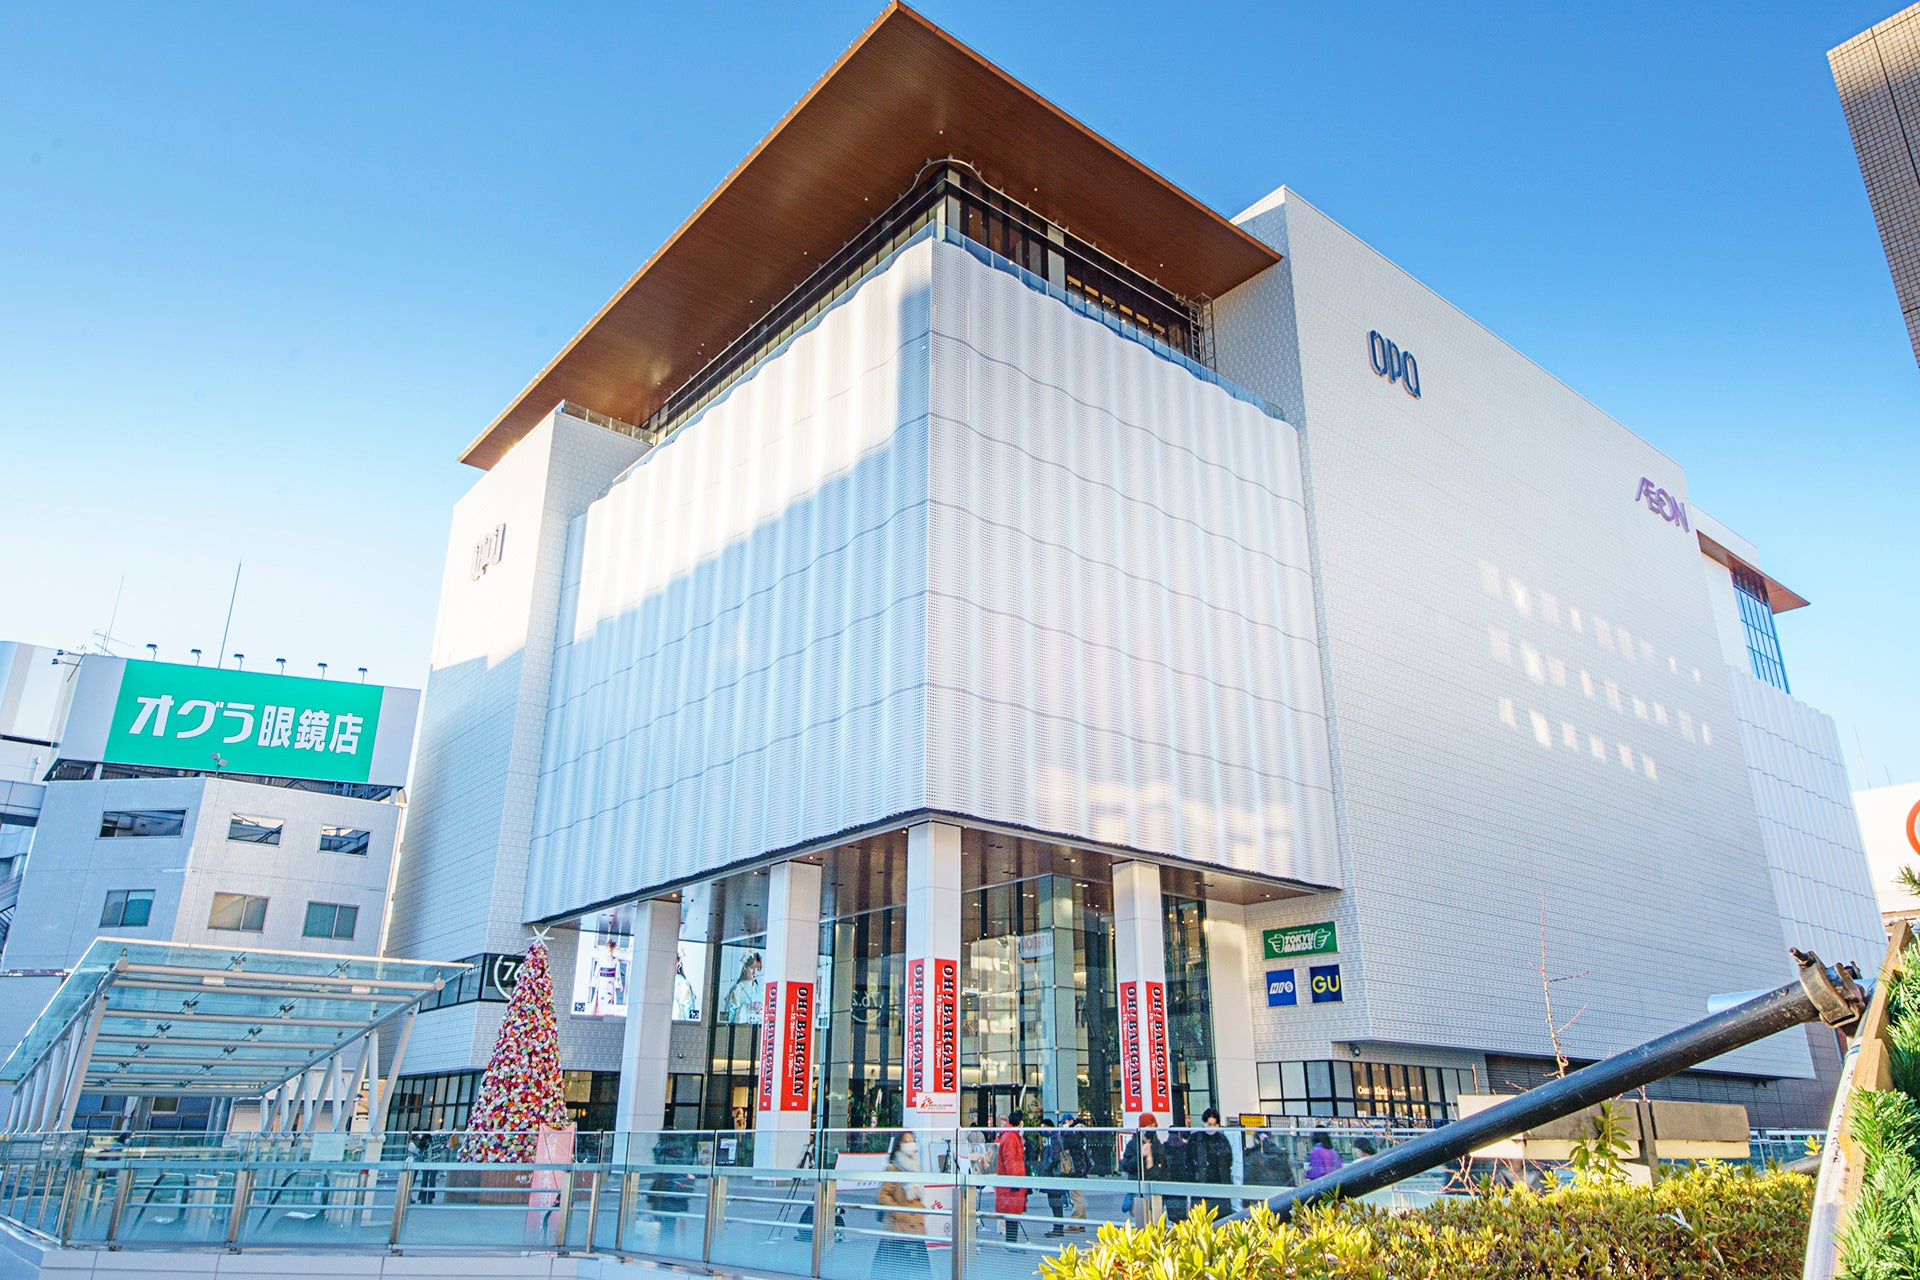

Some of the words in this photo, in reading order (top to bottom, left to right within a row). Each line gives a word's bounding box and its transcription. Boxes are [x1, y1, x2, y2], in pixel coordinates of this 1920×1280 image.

[128, 694, 364, 755] オグラ眼鏡店
[1284, 933, 1314, 945] TOKYU
[1284, 941, 1313, 953] HANDS
[913, 964, 924, 1000] OH!
[941, 964, 954, 1000] OH!
[1269, 981, 1294, 995] HIS
[1312, 975, 1340, 993] GU
[767, 986, 778, 1018] OH!
[796, 986, 809, 1018] OH!
[1126, 986, 1137, 1018] OH!
[1151, 986, 1162, 1018] OH!
[764, 1020, 776, 1097] BARGAIN
[792, 1020, 807, 1097] BARGAIN
[912, 1002, 924, 1091] BARGAIN
[941, 1003, 954, 1091] BARGAIN
[1128, 1020, 1141, 1097] BARGAIN
[1154, 1020, 1167, 1098] BARGAIN
